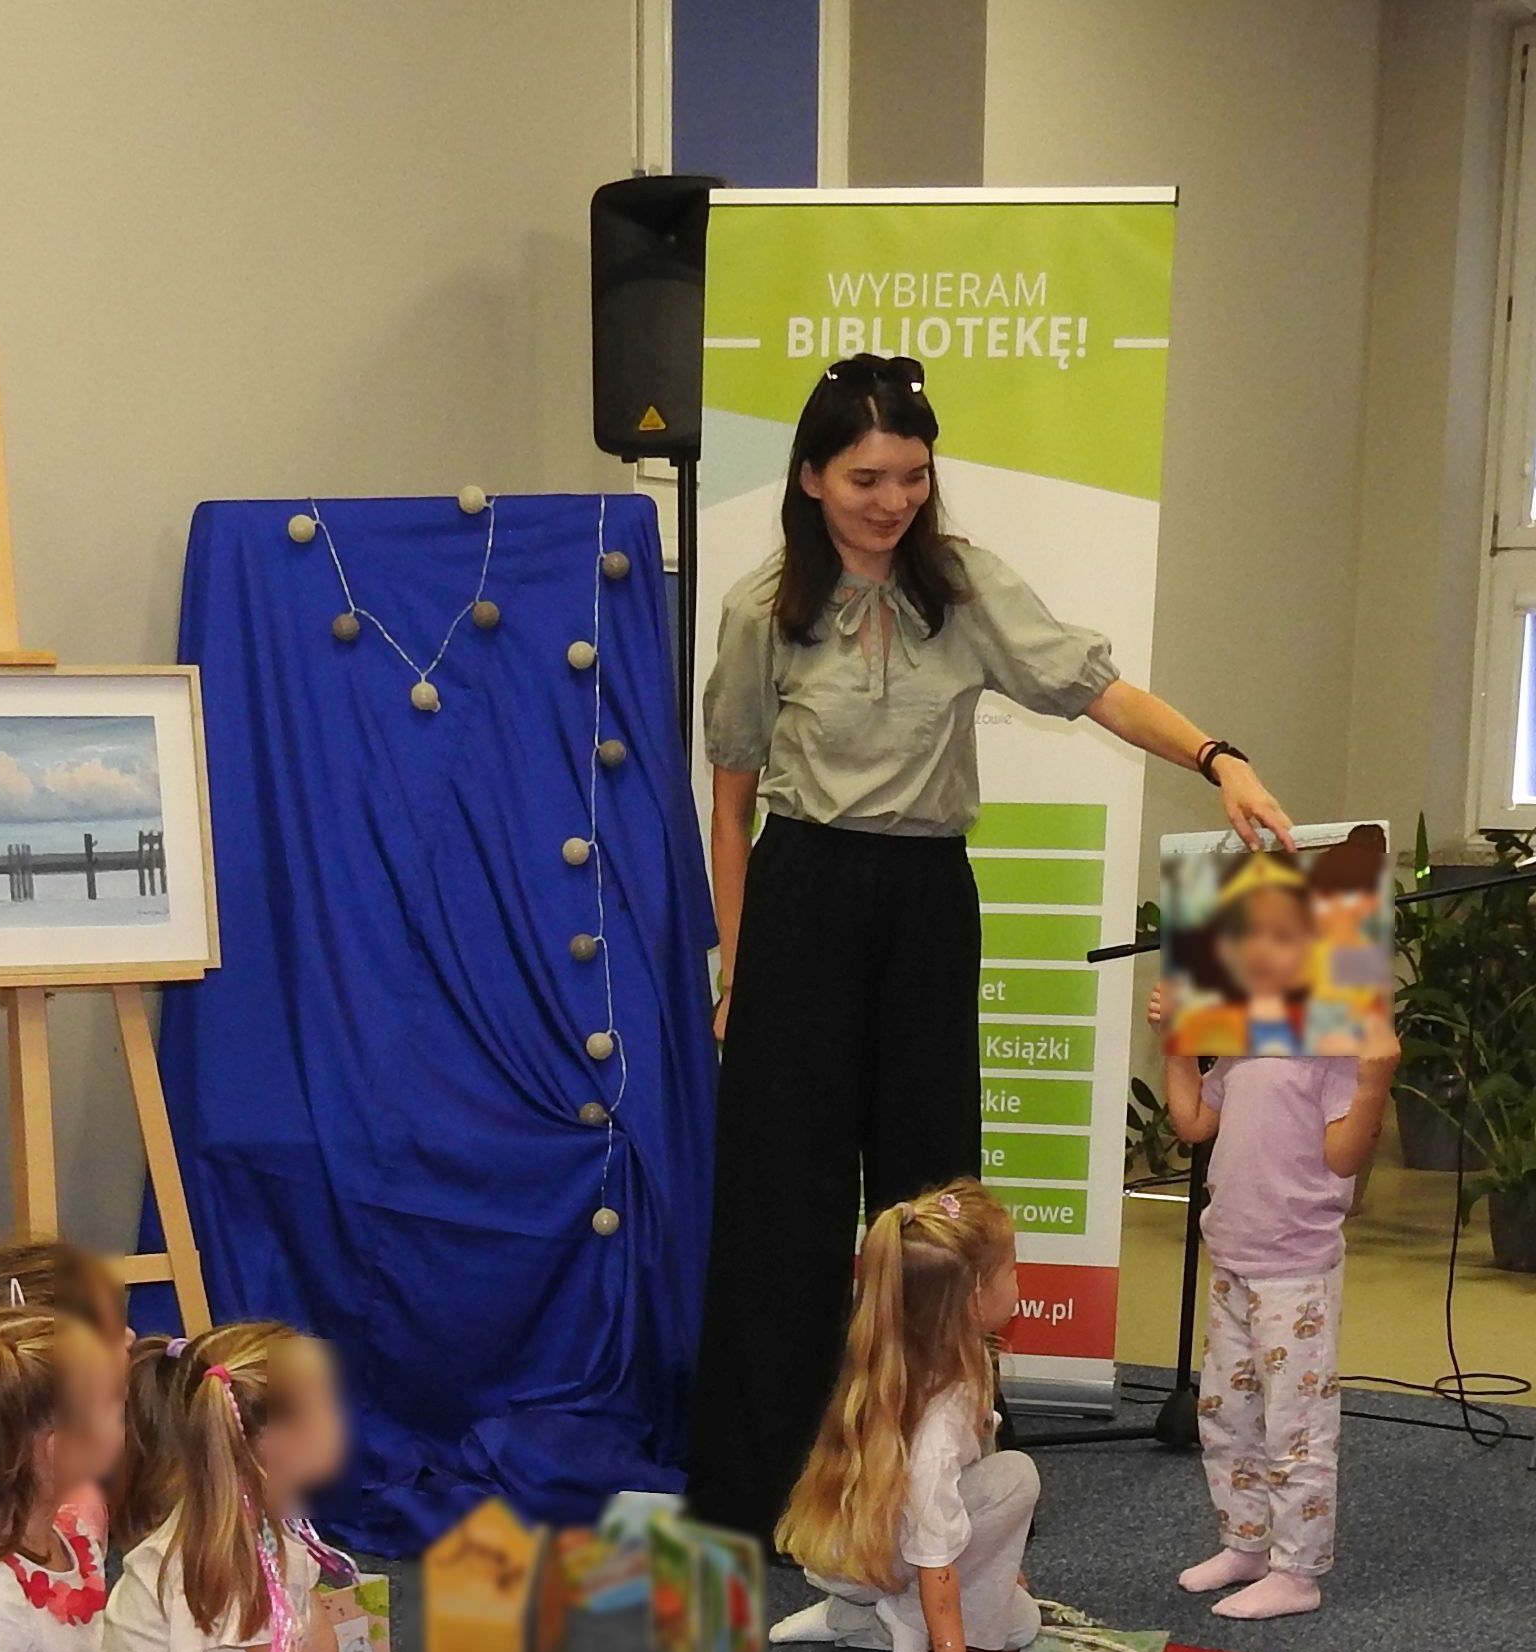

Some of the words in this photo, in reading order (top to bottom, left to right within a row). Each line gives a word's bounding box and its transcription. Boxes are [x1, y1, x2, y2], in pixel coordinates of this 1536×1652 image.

[827, 271, 1047, 308] WYBIERAM
[787, 316, 1088, 370] BIBLIOTEKĘ!
[985, 1035, 1070, 1066] Książki
